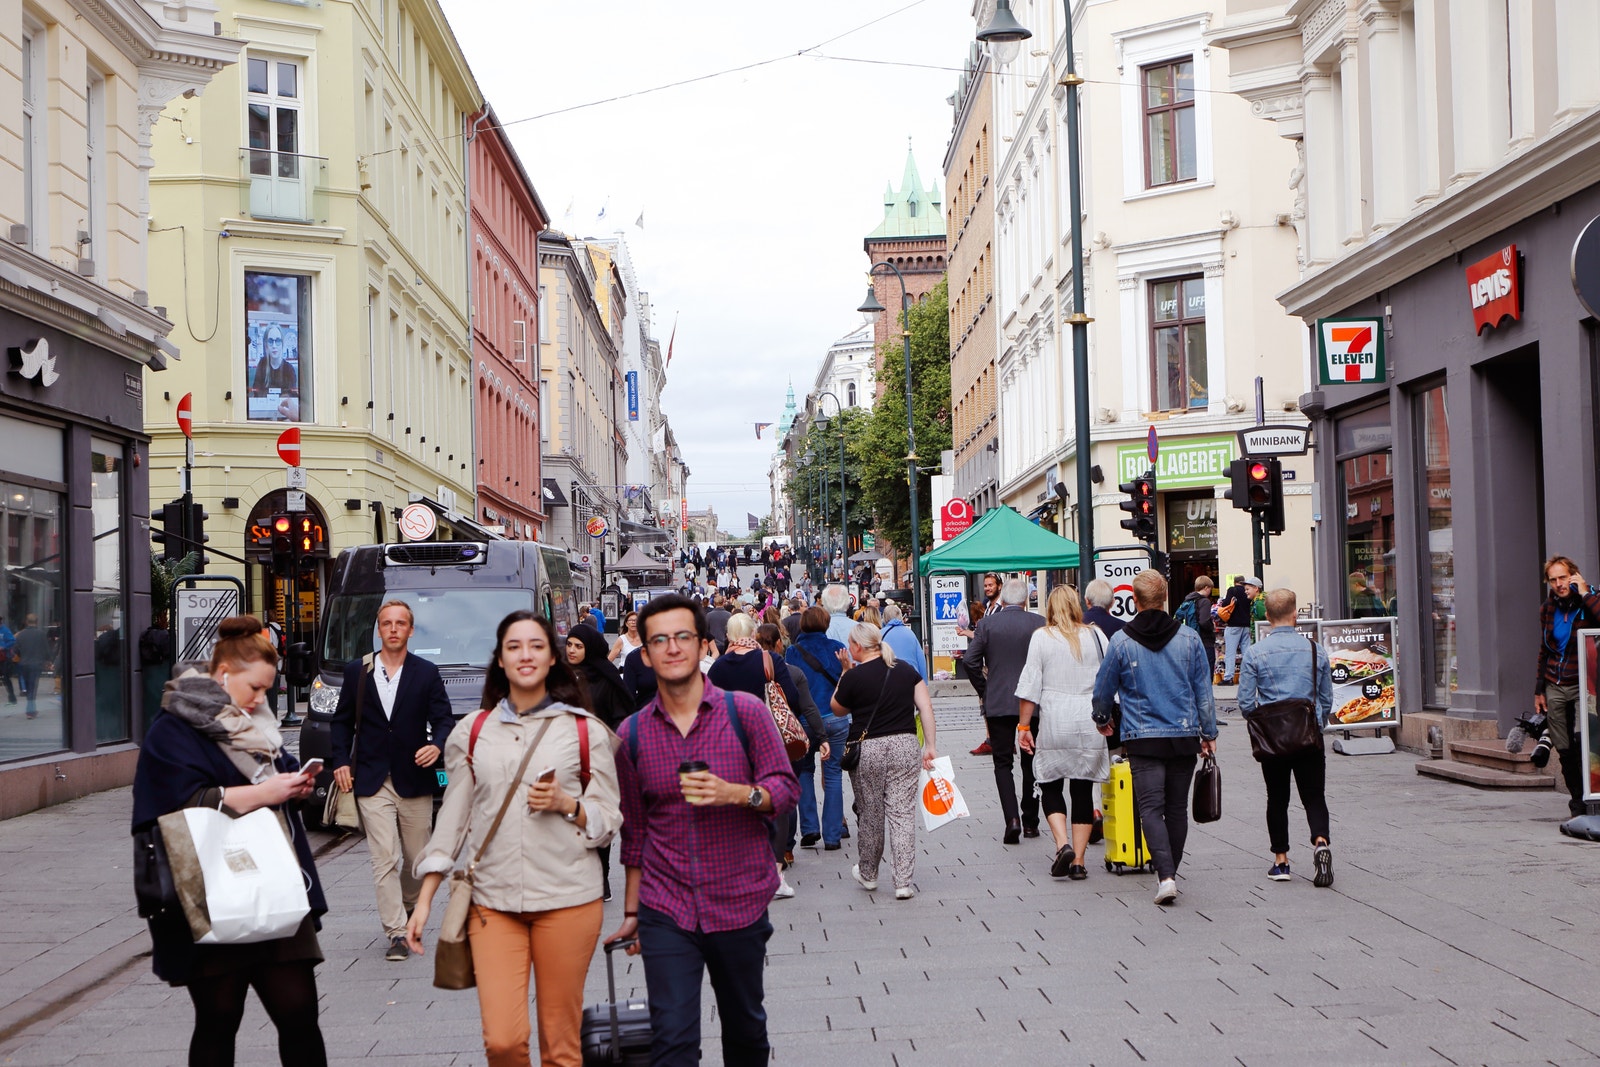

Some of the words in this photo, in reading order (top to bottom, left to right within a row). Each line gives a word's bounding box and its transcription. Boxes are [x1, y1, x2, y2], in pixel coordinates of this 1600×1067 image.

[1331, 326, 1372, 382] 7
[1250, 436, 1301, 446] MINIBANK
[588, 523, 605, 534] KING
[1104, 564, 1141, 577] Sone
[188, 594, 227, 608] Sone
[1111, 595, 1138, 617] 30
[1342, 627, 1372, 635] Nysmurt
[1331, 634, 1384, 643] BAGUETTE
